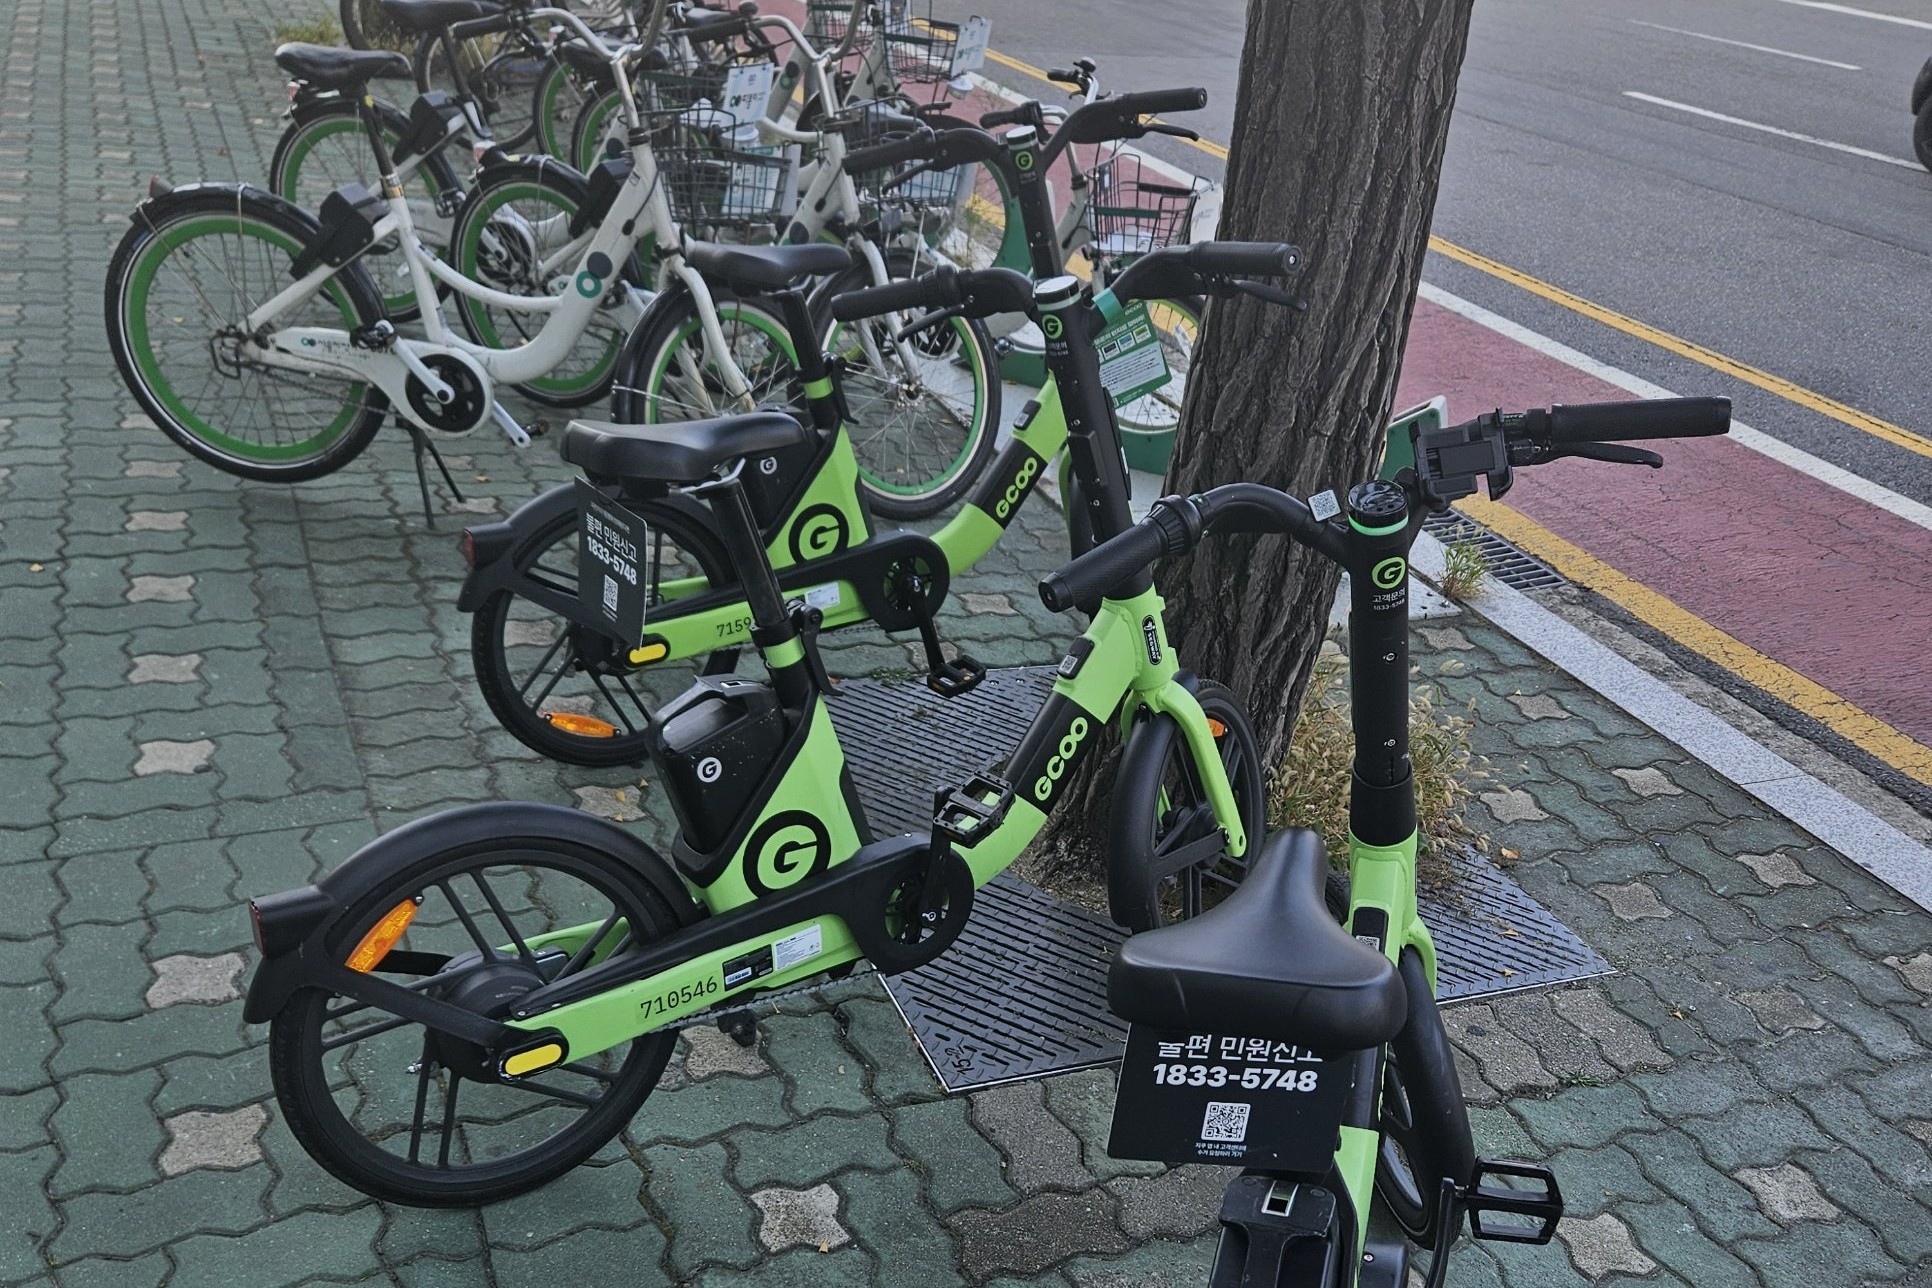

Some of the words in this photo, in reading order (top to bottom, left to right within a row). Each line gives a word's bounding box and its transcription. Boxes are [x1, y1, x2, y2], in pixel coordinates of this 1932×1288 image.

[995, 457, 1038, 519] GCOO
[586, 511, 603, 540] 불편
[603, 527, 638, 564] 민원신고
[586, 535, 638, 586] 1833-5748
[1372, 587, 1406, 603] 고객문의
[1034, 716, 1088, 801] GCOO
[640, 976, 718, 1019] 710546
[1152, 1063, 1319, 1093] 1833-5748
